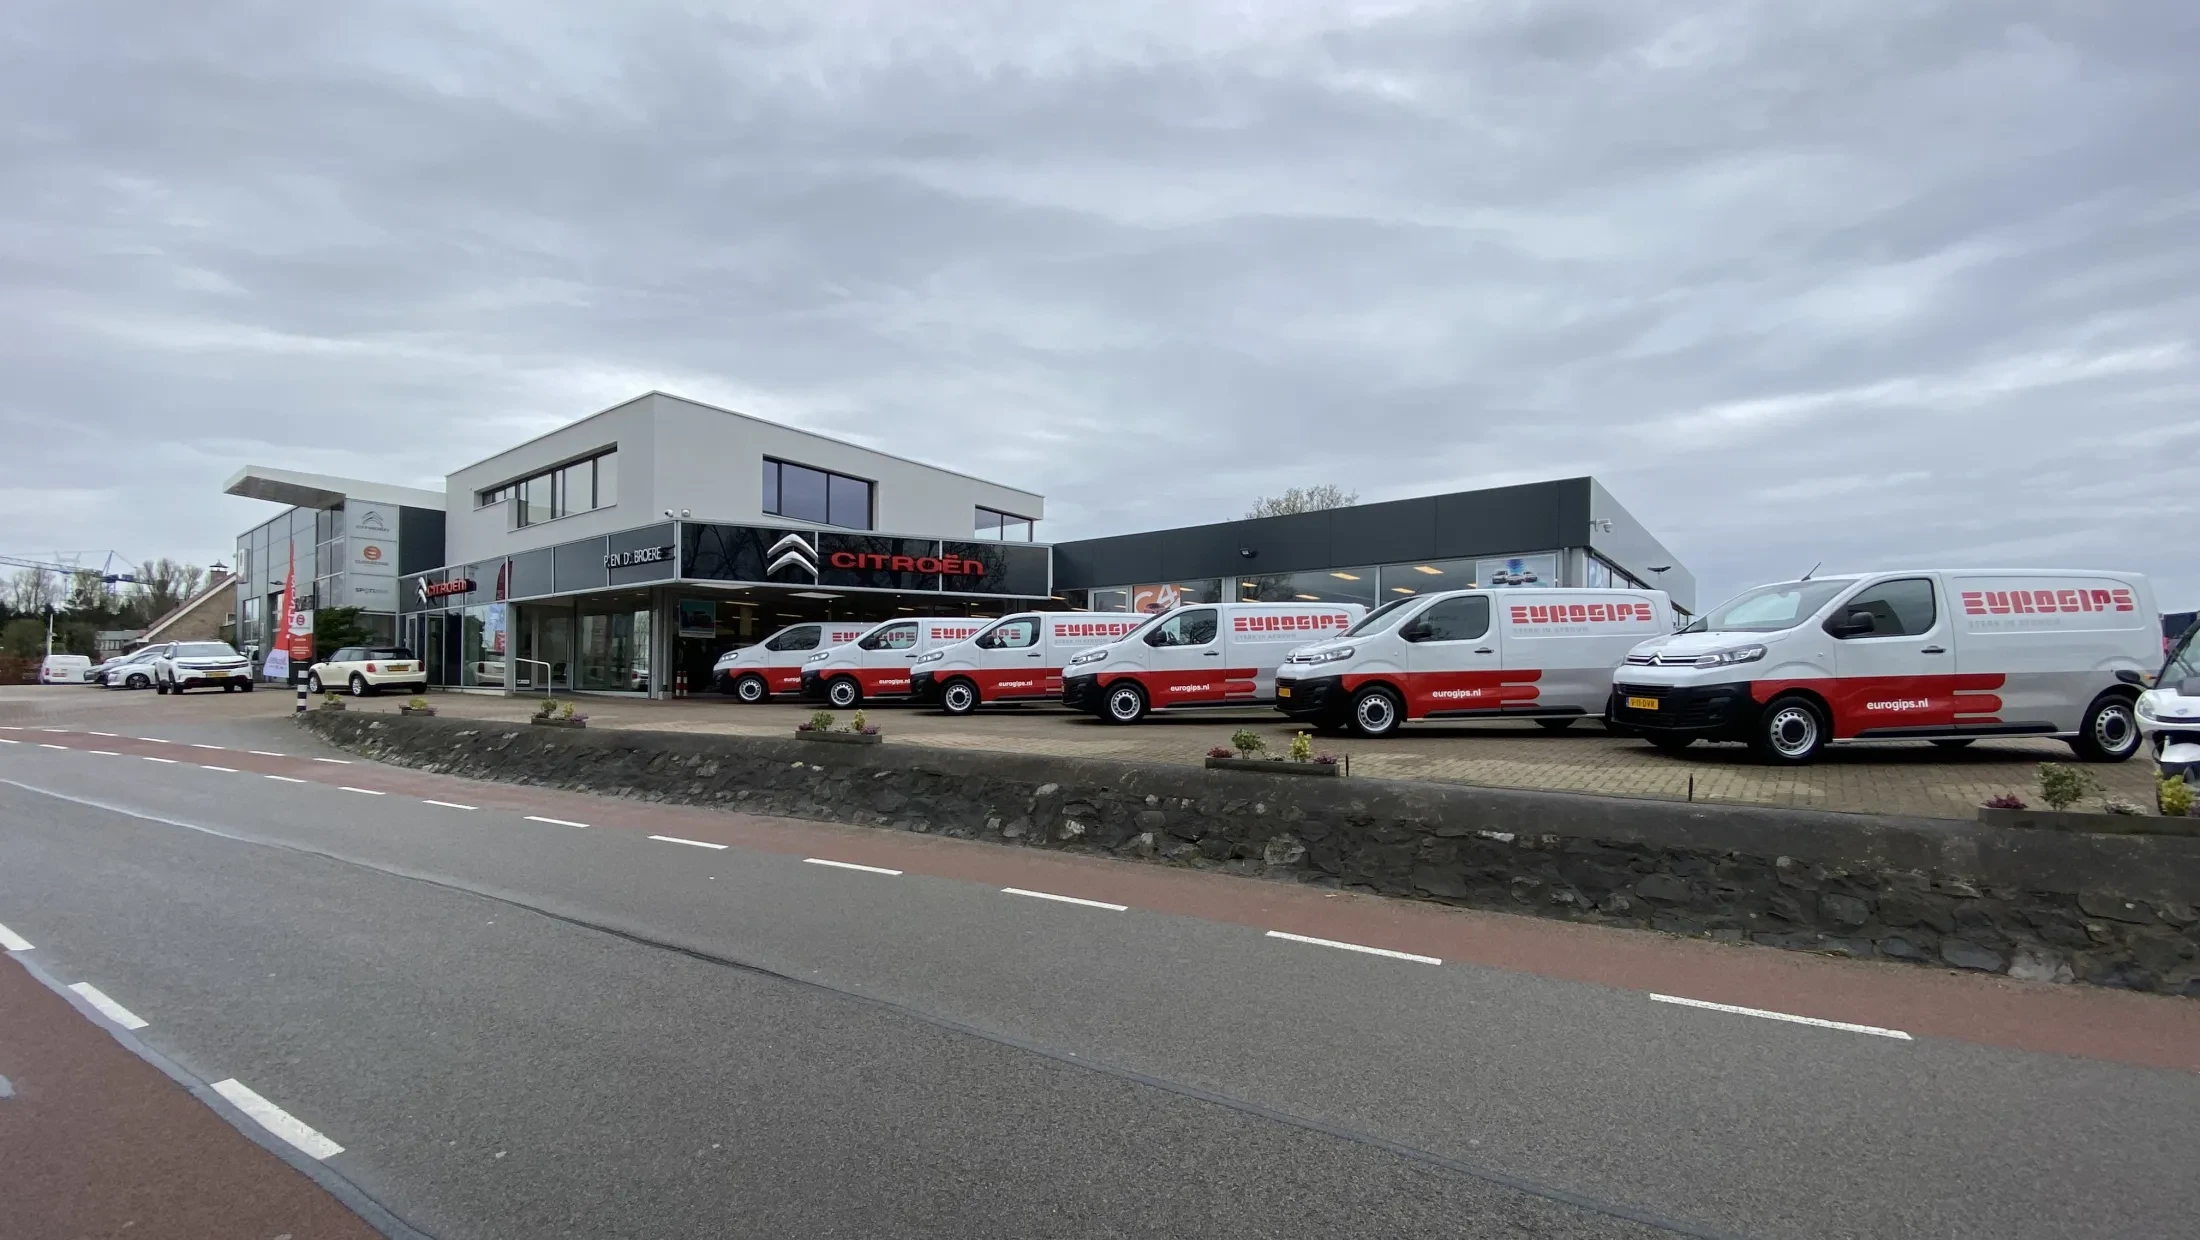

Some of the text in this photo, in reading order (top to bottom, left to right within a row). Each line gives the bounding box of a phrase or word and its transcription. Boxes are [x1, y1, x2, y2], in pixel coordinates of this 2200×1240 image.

[611, 553, 620, 566] EN
[634, 546, 662, 563] BROERE
[1961, 589, 2134, 615] EUROGIPS
[1510, 603, 1652, 624] EUROGIPS
[1233, 614, 1349, 631] EUROGIPS
[1054, 623, 1139, 637] EUROGI
[998, 680, 1033, 688] eurogips.nl
[1170, 684, 1210, 692] eurogips.nl
[1432, 688, 1482, 699] eurogips.nl
[1866, 698, 1929, 711] eurogips.nl
